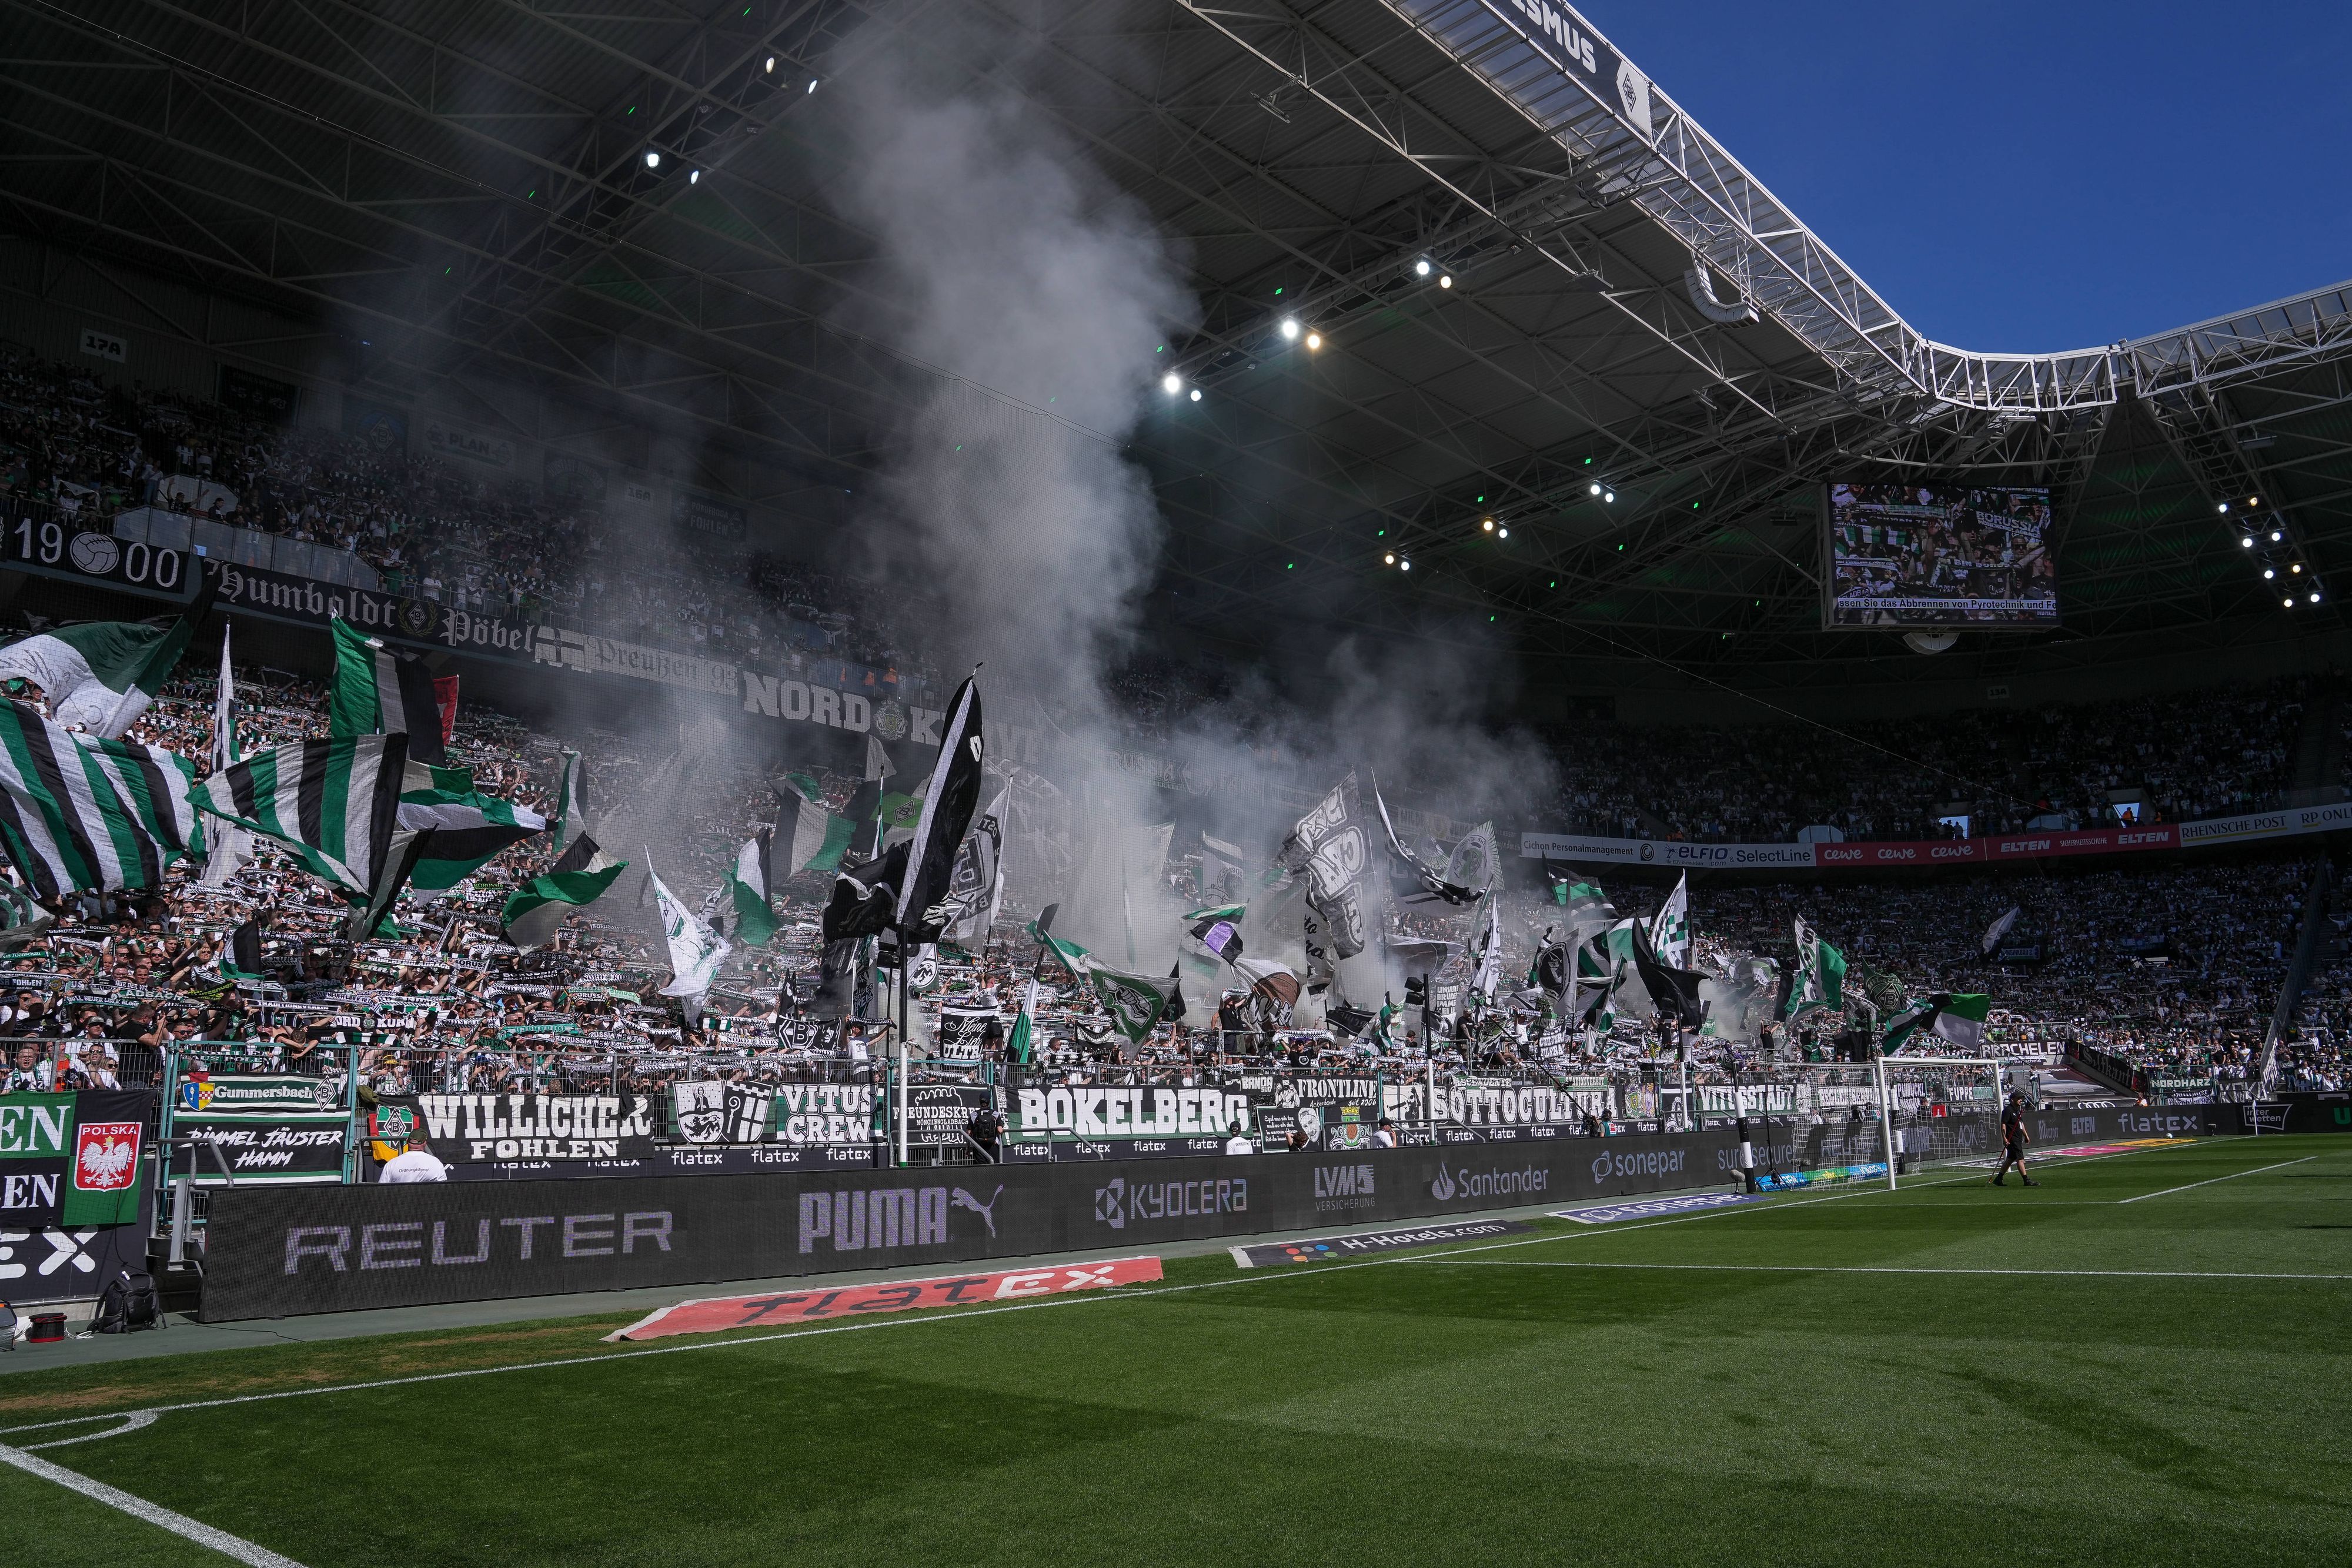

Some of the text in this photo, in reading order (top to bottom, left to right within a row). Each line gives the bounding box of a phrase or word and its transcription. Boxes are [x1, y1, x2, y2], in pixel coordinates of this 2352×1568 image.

[86, 336, 121, 355] 17A
[449, 433, 490, 456] PLAN
[690, 515, 729, 537] FOHLEN
[1976, 511, 2040, 534] BORUSSIA
[15, 518, 180, 588] 19 00
[204, 557, 536, 653] Humboldt Pöbel
[1863, 598, 1878, 608] Sie
[1881, 598, 1897, 608] das
[1900, 599, 1949, 609] Abbrennen
[1971, 600, 2024, 610] Pyrotechnik
[2027, 600, 2044, 609] und
[587, 636, 697, 679] Preußen
[742, 670, 871, 733] NORD
[2182, 815, 2287, 838] RHEINISCHE POST
[2300, 813, 2318, 824] RP
[1523, 840, 1633, 856] Cichon Personalmanagement
[1931, 844, 1973, 858] cewe
[2001, 840, 2050, 852] ELTEN
[2118, 832, 2169, 844] ELTEN
[1736, 849, 1811, 862] SelectLine
[1824, 848, 1863, 860] cewe
[1877, 847, 1916, 860] cewe
[555, 1034, 593, 1044] BORUSSIA
[1982, 1041, 2066, 1058] BRACHELEN
[214, 1085, 313, 1099] Gummersbach
[1297, 1078, 1378, 1099] FRONTLINE
[2151, 1078, 2211, 1088] NORDHARZ
[780, 1082, 880, 1115] VITUS
[1361, 1098, 1377, 1106] 2006
[1949, 1086, 1973, 1101] FUPPE
[419, 1095, 653, 1139] WILLICHER
[1637, 1121, 1658, 1132] flatex
[2071, 1116, 2096, 1135] ELTEN
[2117, 1112, 2198, 1132] flatex
[82, 1125, 138, 1136] POLSKA
[261, 1126, 343, 1148] JÄUSTER
[784, 1114, 873, 1144] CREW
[1489, 1127, 1516, 1139] flatex
[1530, 1125, 1556, 1138] flatex
[2037, 1119, 2059, 1142] Bitburger
[470, 1139, 619, 1159] FOHLEN
[826, 1147, 871, 1161] flatex
[1133, 1140, 1167, 1152] flatex
[1187, 1138, 1219, 1151] flatex
[234, 1148, 294, 1169] HAMM
[670, 1151, 723, 1166] flatex
[751, 1149, 800, 1164] flatex
[1615, 1148, 1685, 1177] sonepar
[1314, 1165, 1355, 1198] LVM
[1459, 1165, 1549, 1199] Santander
[1315, 1197, 1375, 1211] VERSICHERUNG
[799, 1186, 947, 1253] PUMA
[284, 1210, 673, 1275] REUTER
[1341, 1222, 1507, 1249] H-Hotels.com
